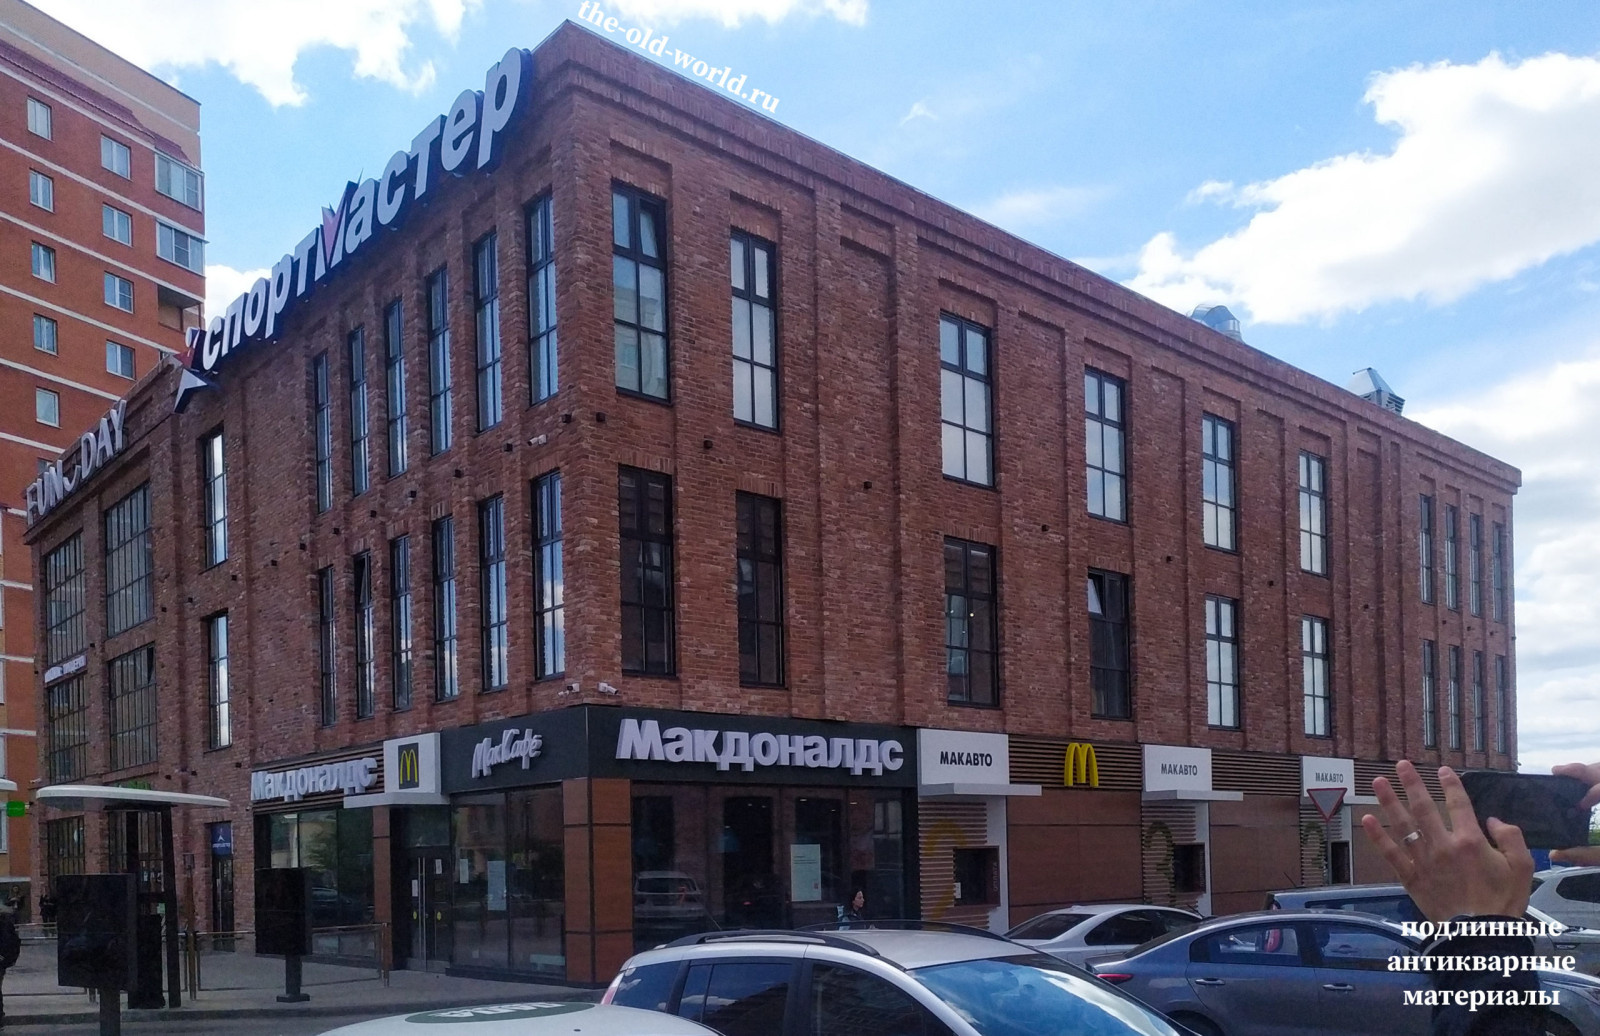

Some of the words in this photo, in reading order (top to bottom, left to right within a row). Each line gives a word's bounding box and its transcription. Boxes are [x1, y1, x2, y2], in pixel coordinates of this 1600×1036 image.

[26, 459, 63, 526] FUN
[81, 399, 127, 479] DAY
[615, 718, 904, 776] Макдоналдс
[939, 750, 993, 767] МАКАВТО
[250, 757, 378, 802] Макдоналдс
[1160, 762, 1198, 776] МАКАВТО
[1315, 772, 1344, 783] МАКАВТО
